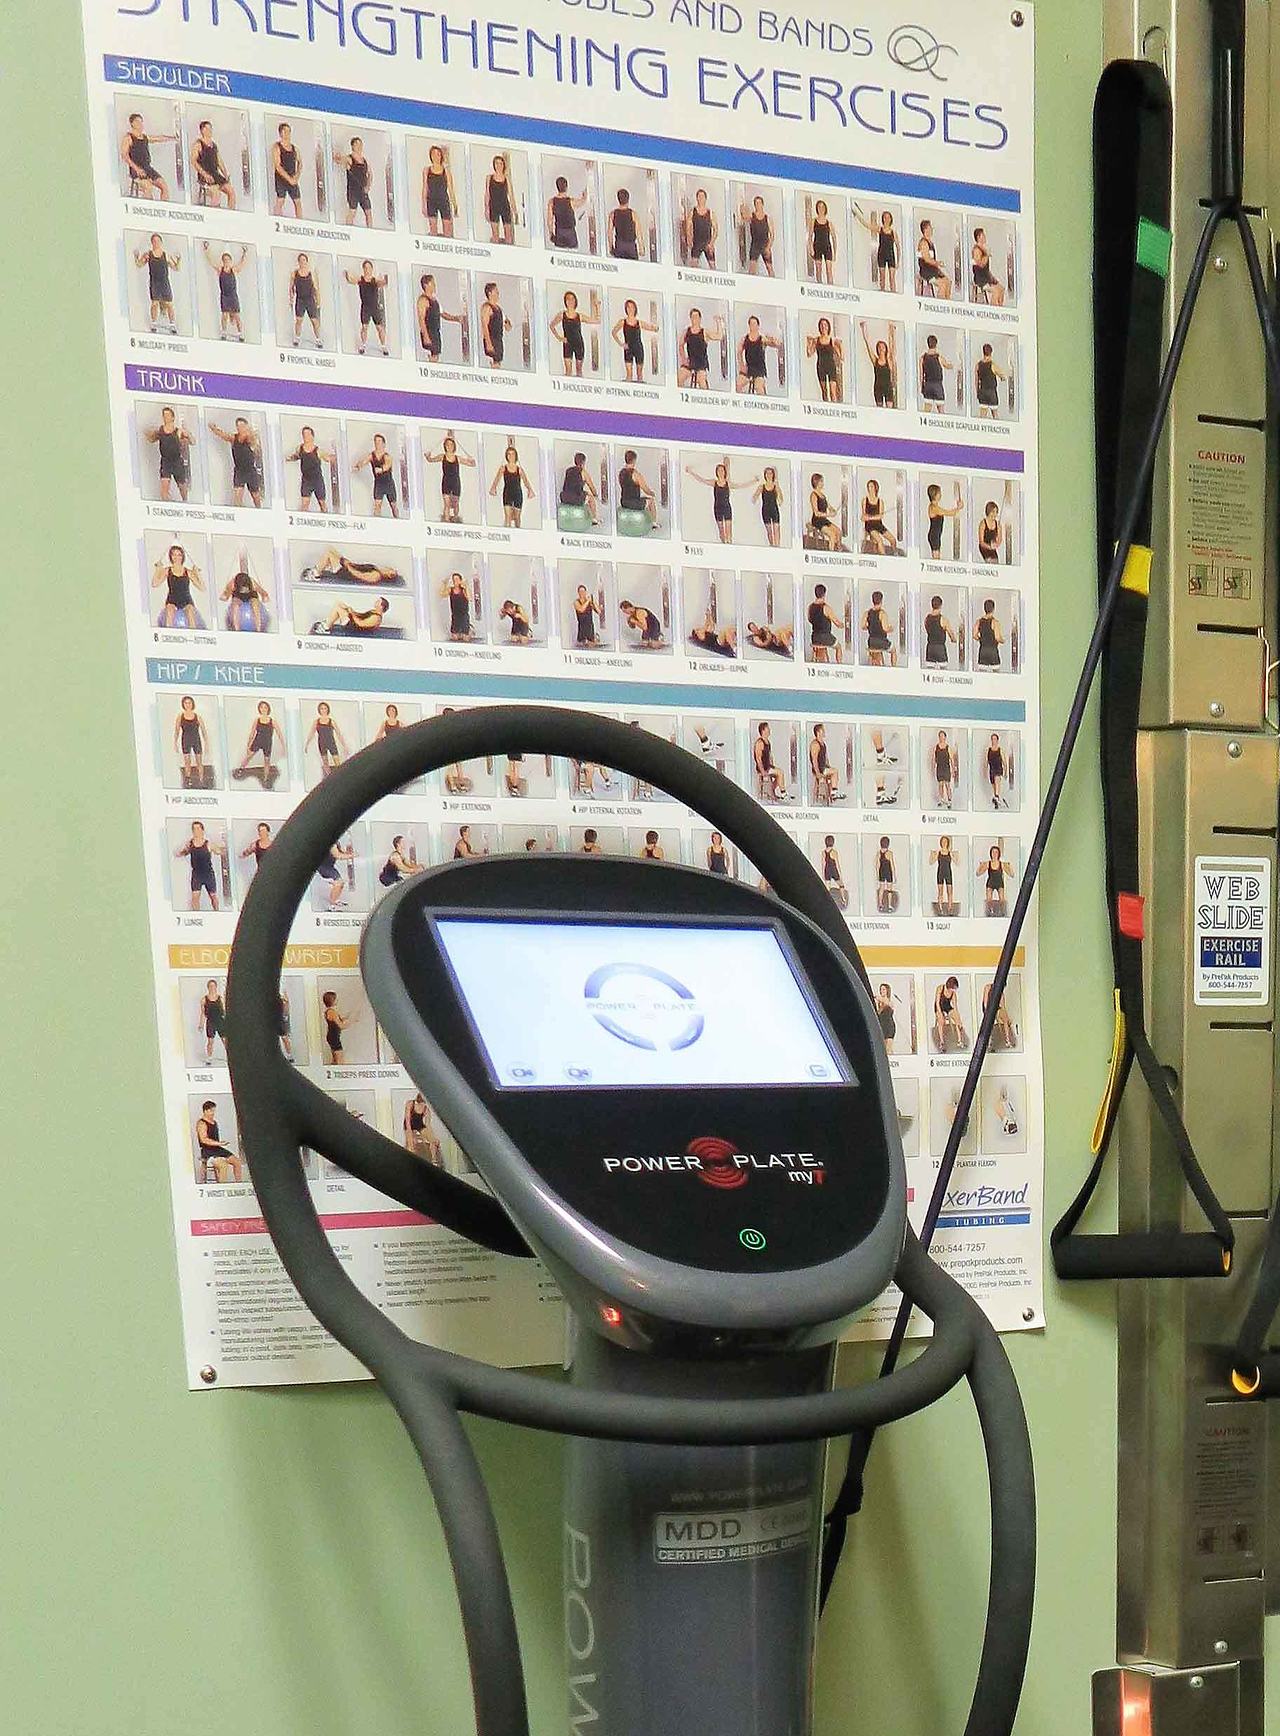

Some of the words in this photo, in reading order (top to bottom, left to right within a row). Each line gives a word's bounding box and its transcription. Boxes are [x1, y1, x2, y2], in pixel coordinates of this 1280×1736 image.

[670, 0, 742, 35] AND
[759, 11, 873, 56] BANDS
[117, 58, 231, 94] SHOULDER
[698, 57, 1009, 150] EXERCISES
[275, 222, 279, 231] 2
[282, 224, 314, 237] SHOULDER
[279, 354, 285, 362] 9
[287, 354, 313, 365] FRONTAL
[137, 369, 205, 392] TRUNK
[419, 367, 428, 376] 10
[430, 369, 460, 380] SHOULDER
[1197, 450, 1246, 465] CAUTION
[157, 662, 188, 680] HIP
[215, 665, 264, 683] KNEE
[442, 801, 447, 809] 3
[1203, 875, 1260, 900] WEB
[1197, 904, 1264, 930] SLIDE
[1203, 939, 1259, 952] EXERCISE
[180, 949, 231, 964] ELBO
[282, 949, 342, 964] WRIST
[1215, 953, 1246, 966] RAIL
[1232, 973, 1259, 981] Products
[326, 1070, 330, 1078] 2
[358, 1070, 376, 1078] PRESS
[603, 1154, 704, 1174] POWER
[943, 1182, 1028, 1208] xerBand
[955, 1216, 1005, 1225] TUBING
[665, 1519, 743, 1542] MDD
[659, 1549, 726, 1561] CERTIFIED
[728, 1542, 779, 1557] MEDICAL
